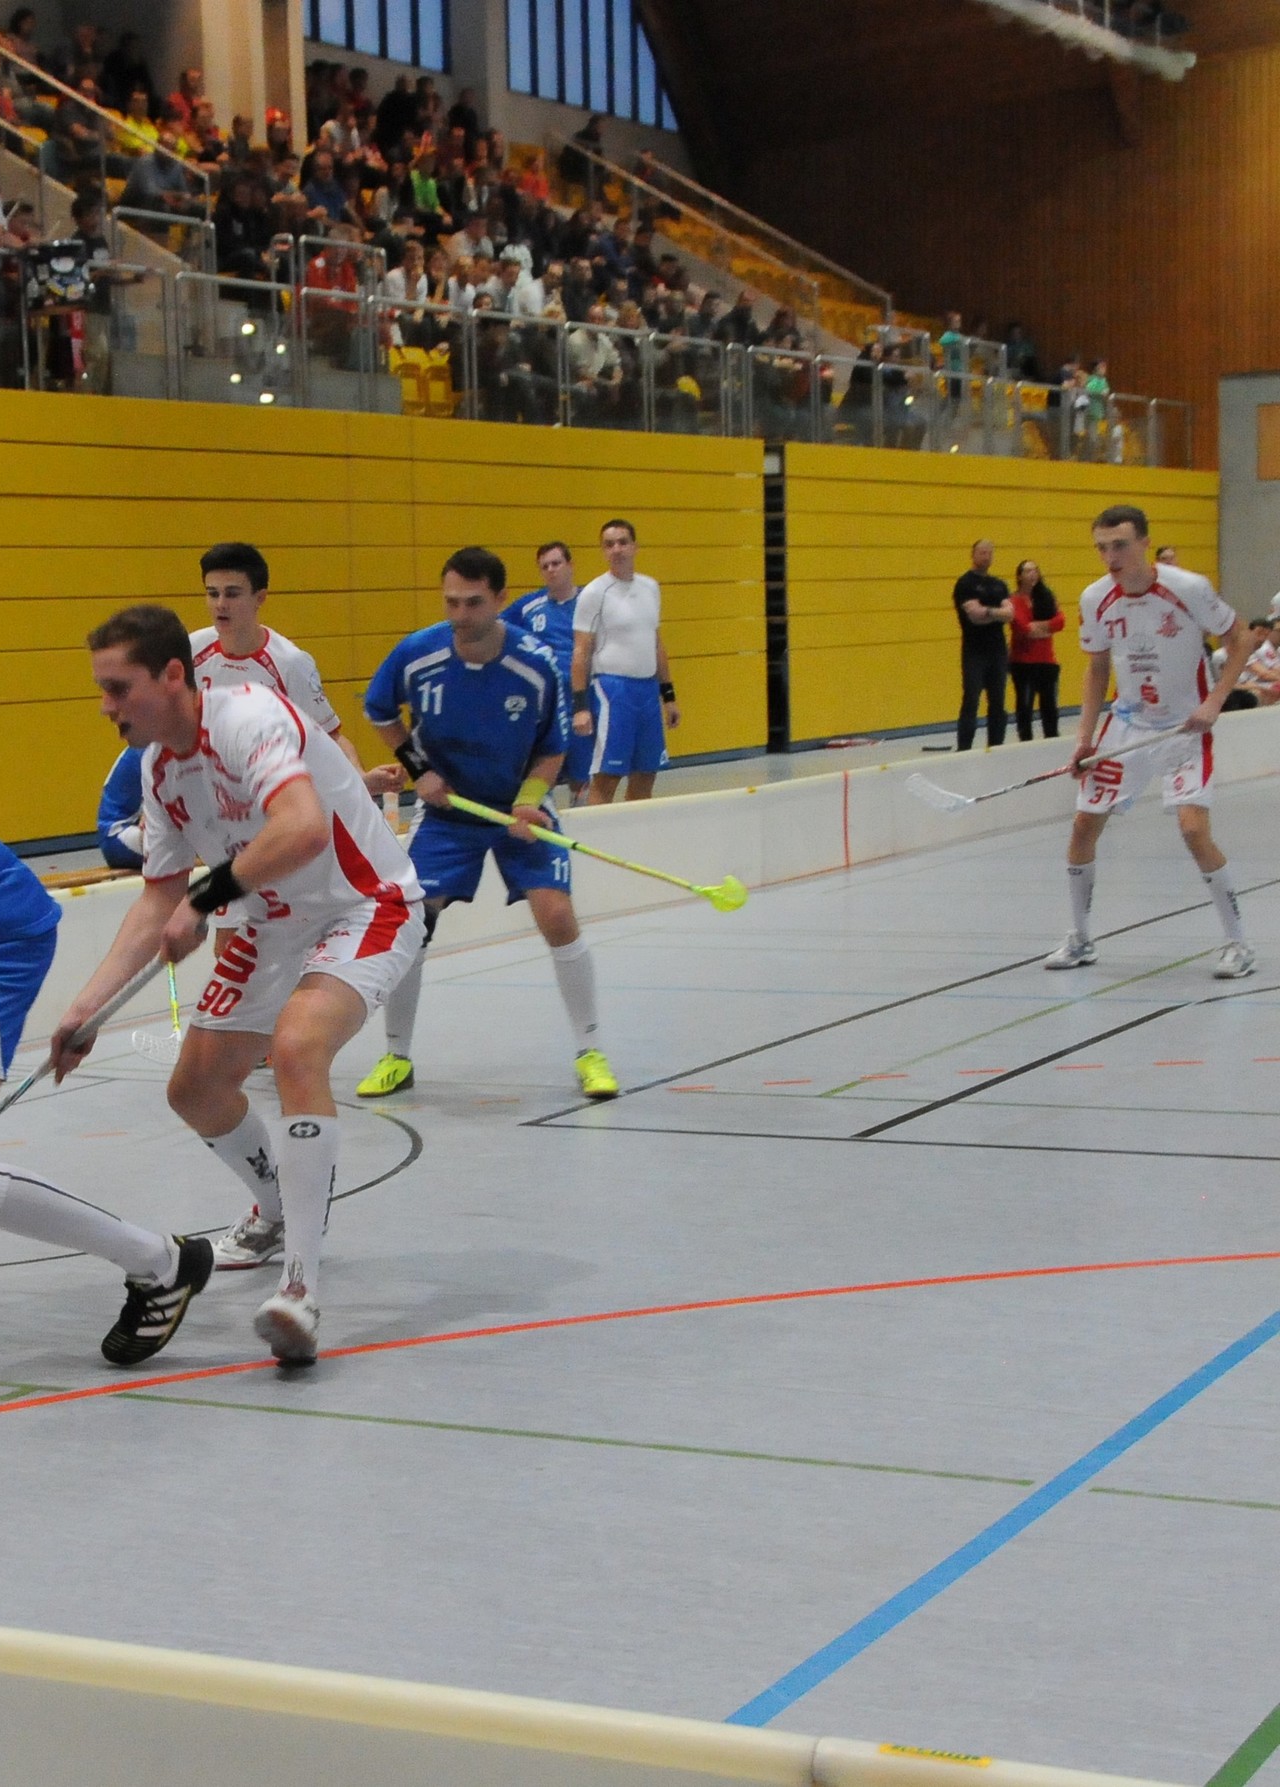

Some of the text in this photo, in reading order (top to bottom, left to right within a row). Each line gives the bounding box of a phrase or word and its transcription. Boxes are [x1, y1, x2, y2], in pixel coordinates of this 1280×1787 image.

[531, 613, 547, 632] 19
[417, 681, 444, 715] 11
[1088, 786, 1120, 806] 37
[551, 857, 569, 883] 11
[196, 979, 243, 1017] 90
